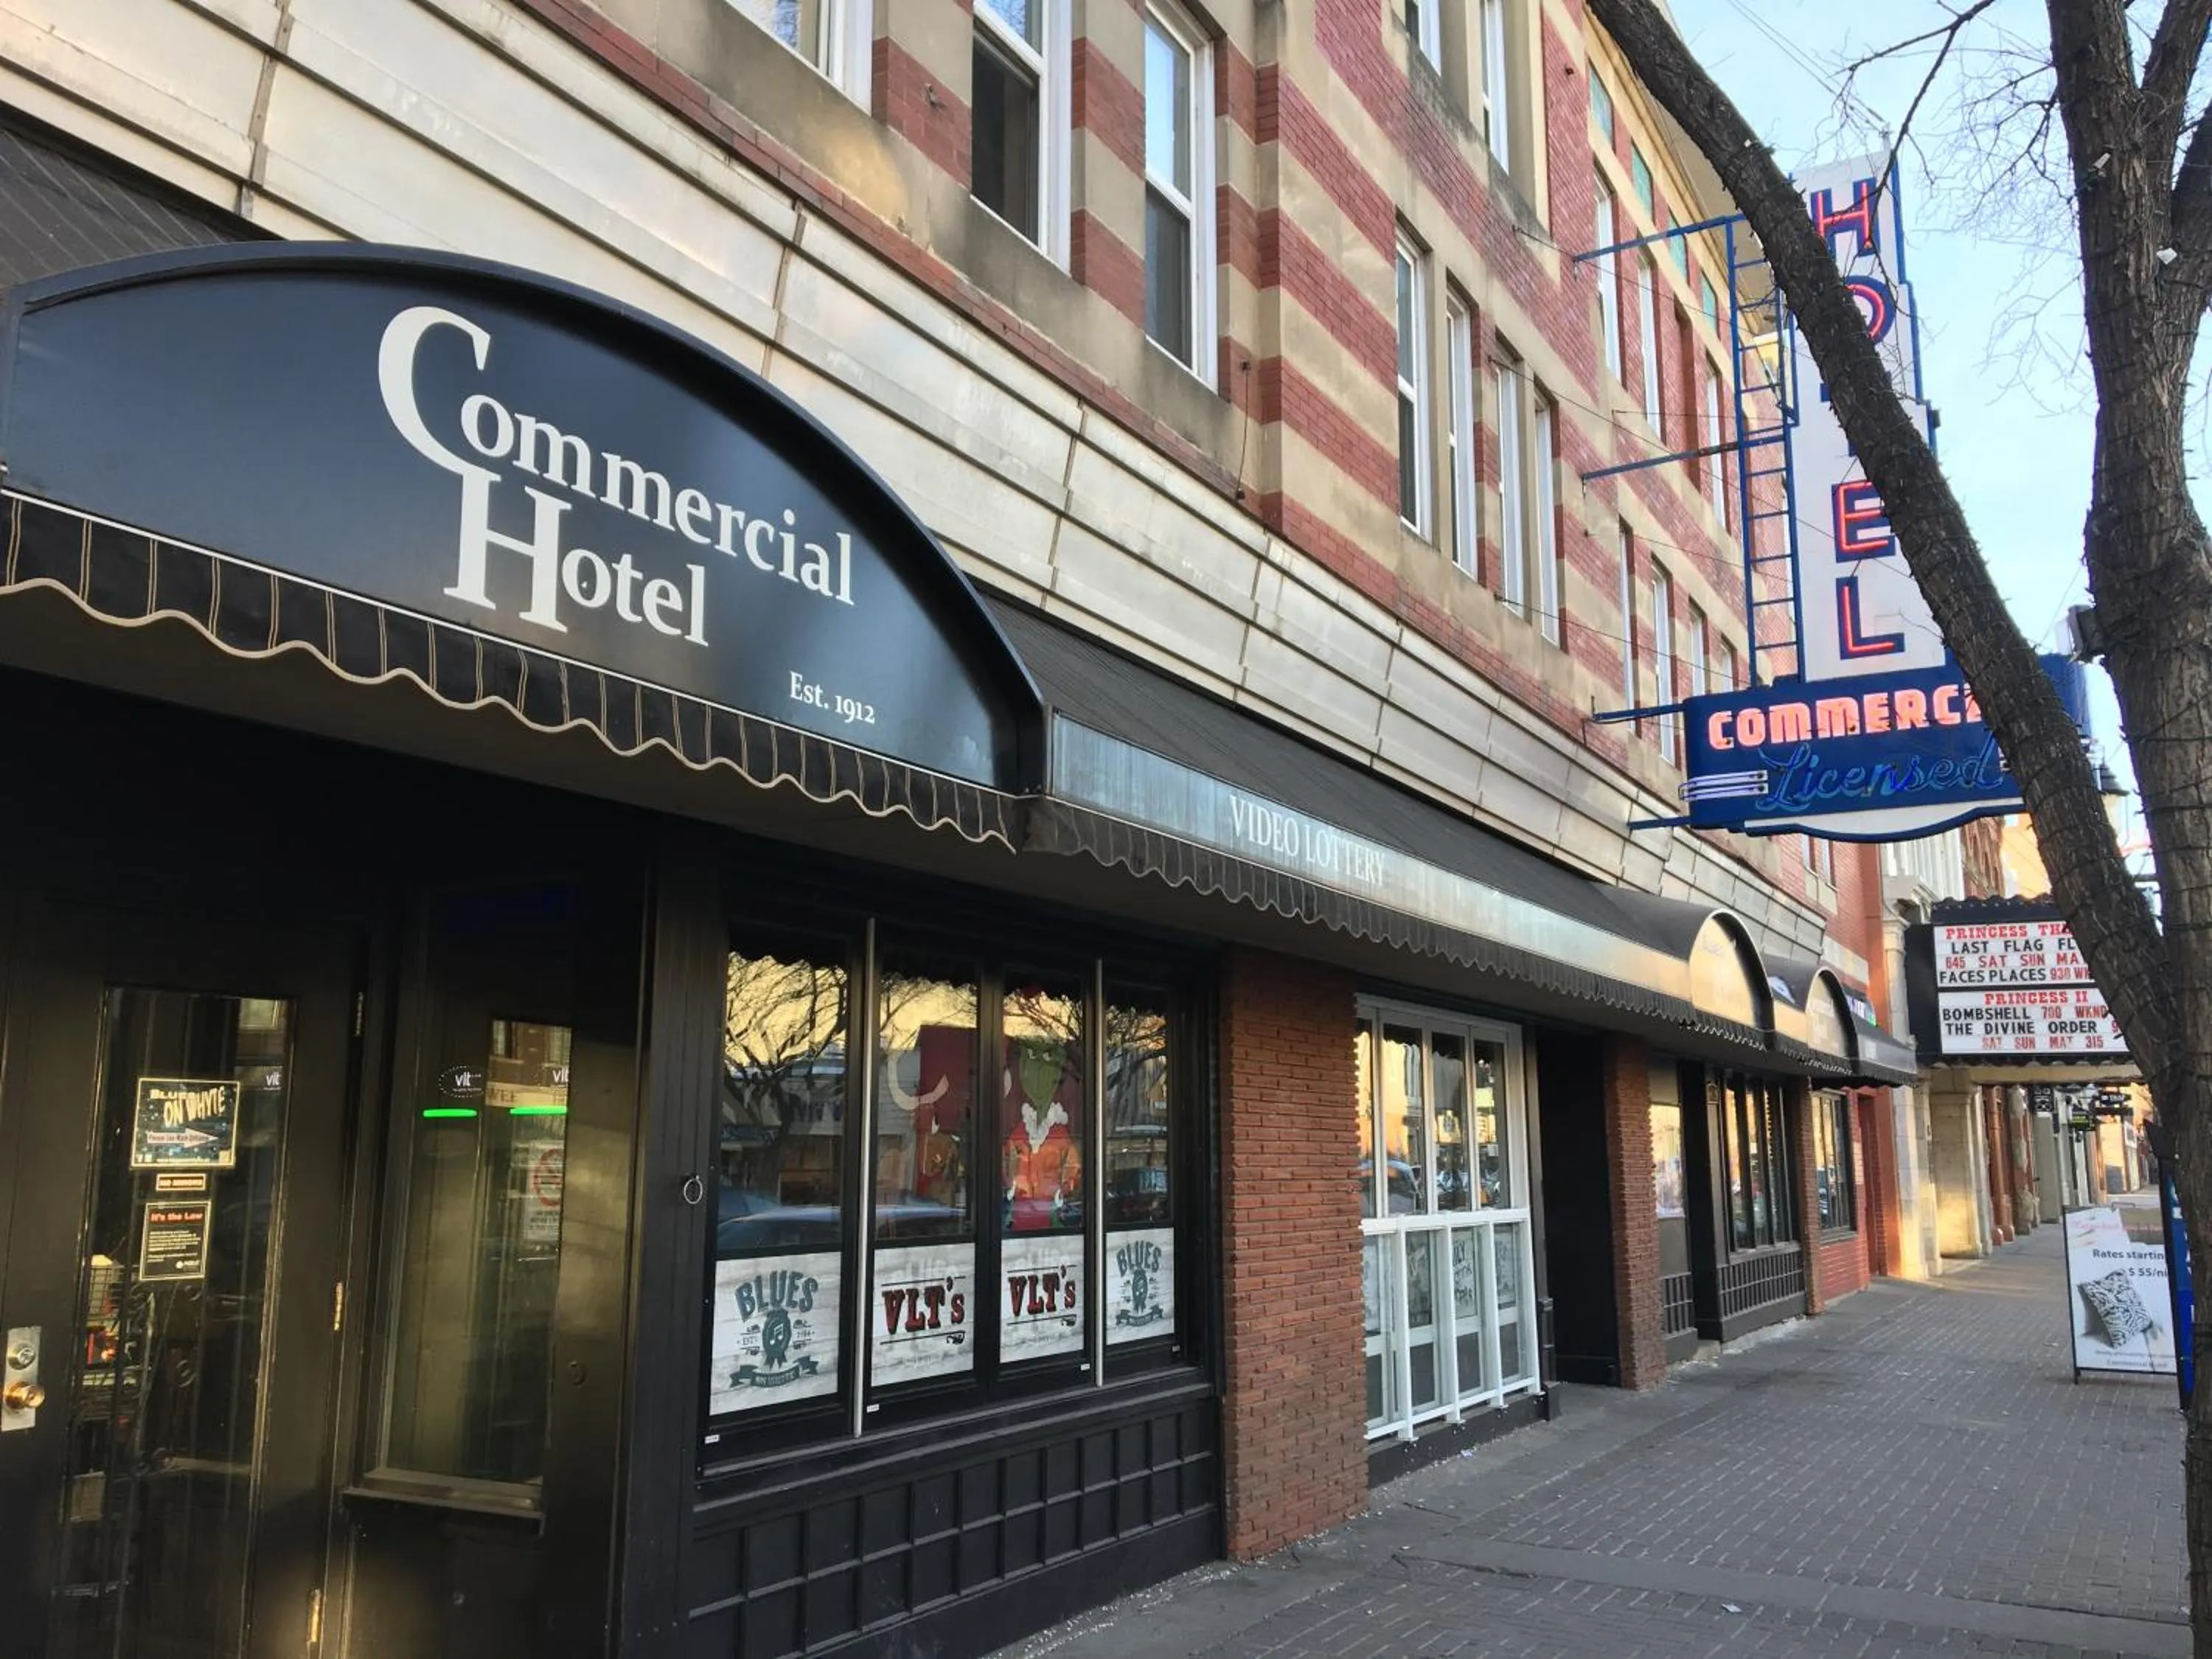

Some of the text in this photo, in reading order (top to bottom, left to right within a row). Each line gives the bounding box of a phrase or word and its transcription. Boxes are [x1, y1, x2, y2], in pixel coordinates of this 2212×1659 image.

[378, 305, 855, 605] Commercial
[443, 469, 709, 647] Hotel
[790, 670, 875, 724] Est. 1912
[1708, 683, 1982, 750] COMMERCI
[1755, 731, 2004, 812] Licensed
[1229, 795, 1385, 886] VIDEO LOTTERY
[1946, 925, 2028, 939] PRINCESS
[1951, 938, 2076, 954] LAST FLAG FL
[1978, 956, 2008, 968] SAT
[2020, 953, 2045, 967] SUN
[2056, 953, 2079, 965] MA
[1939, 970, 1985, 984] FACES
[1989, 968, 2046, 982] PLACES
[1984, 991, 2088, 1005] PRINCESS II
[1943, 1007, 2031, 1021] BOMBSHELL
[1946, 1023, 1973, 1036] THE
[1984, 1021, 2035, 1035] DIVINE
[2048, 1020, 2097, 1034] ORDER
[2014, 1037, 2036, 1049] SUN
[2085, 1035, 2104, 1048] 315
[164, 1085, 226, 1127] ON WHYTE
[1115, 1239, 1162, 1279] BLUES
[2093, 1248, 2165, 1260] Rates startin
[734, 1270, 819, 1324] BLUES
